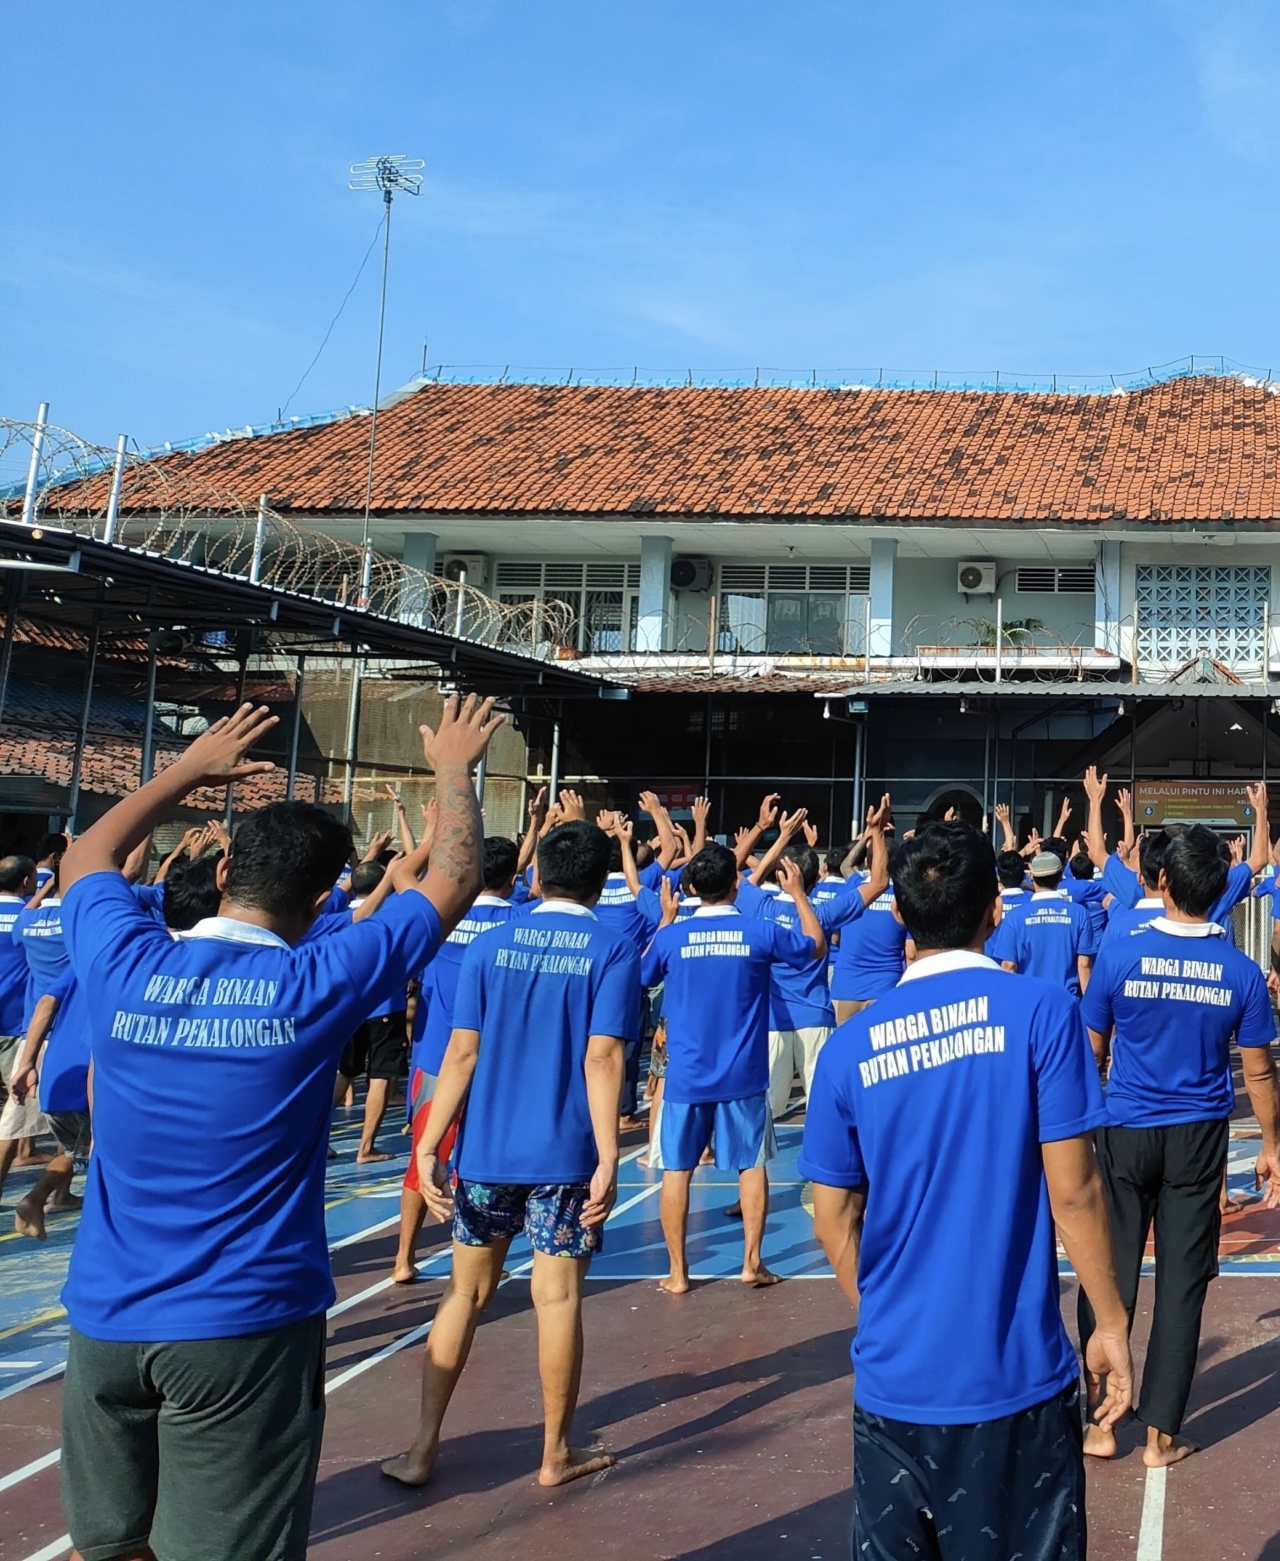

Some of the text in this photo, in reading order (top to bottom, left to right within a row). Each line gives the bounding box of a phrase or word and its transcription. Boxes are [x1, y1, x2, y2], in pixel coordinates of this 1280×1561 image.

[1139, 787, 1259, 796] MELALUI PINTU INI HARS
[513, 927, 552, 948] WARGA
[551, 930, 592, 949] BINAAN
[688, 930, 744, 945] WARGA BINAAN
[495, 948, 530, 971] RUTAN
[680, 943, 751, 959] RUTAN PEKALONGAN
[1141, 957, 1224, 982] WARGA BINAAN
[143, 974, 279, 1007] WARGA BINAAN
[1123, 979, 1233, 1007] RUTAN PEKALONGAN
[110, 1010, 296, 1048] RUTAN PEKALONGAN
[868, 995, 989, 1051] WARGA BINAAN
[858, 1025, 1006, 1089] RUTAN PEKALONGAN
